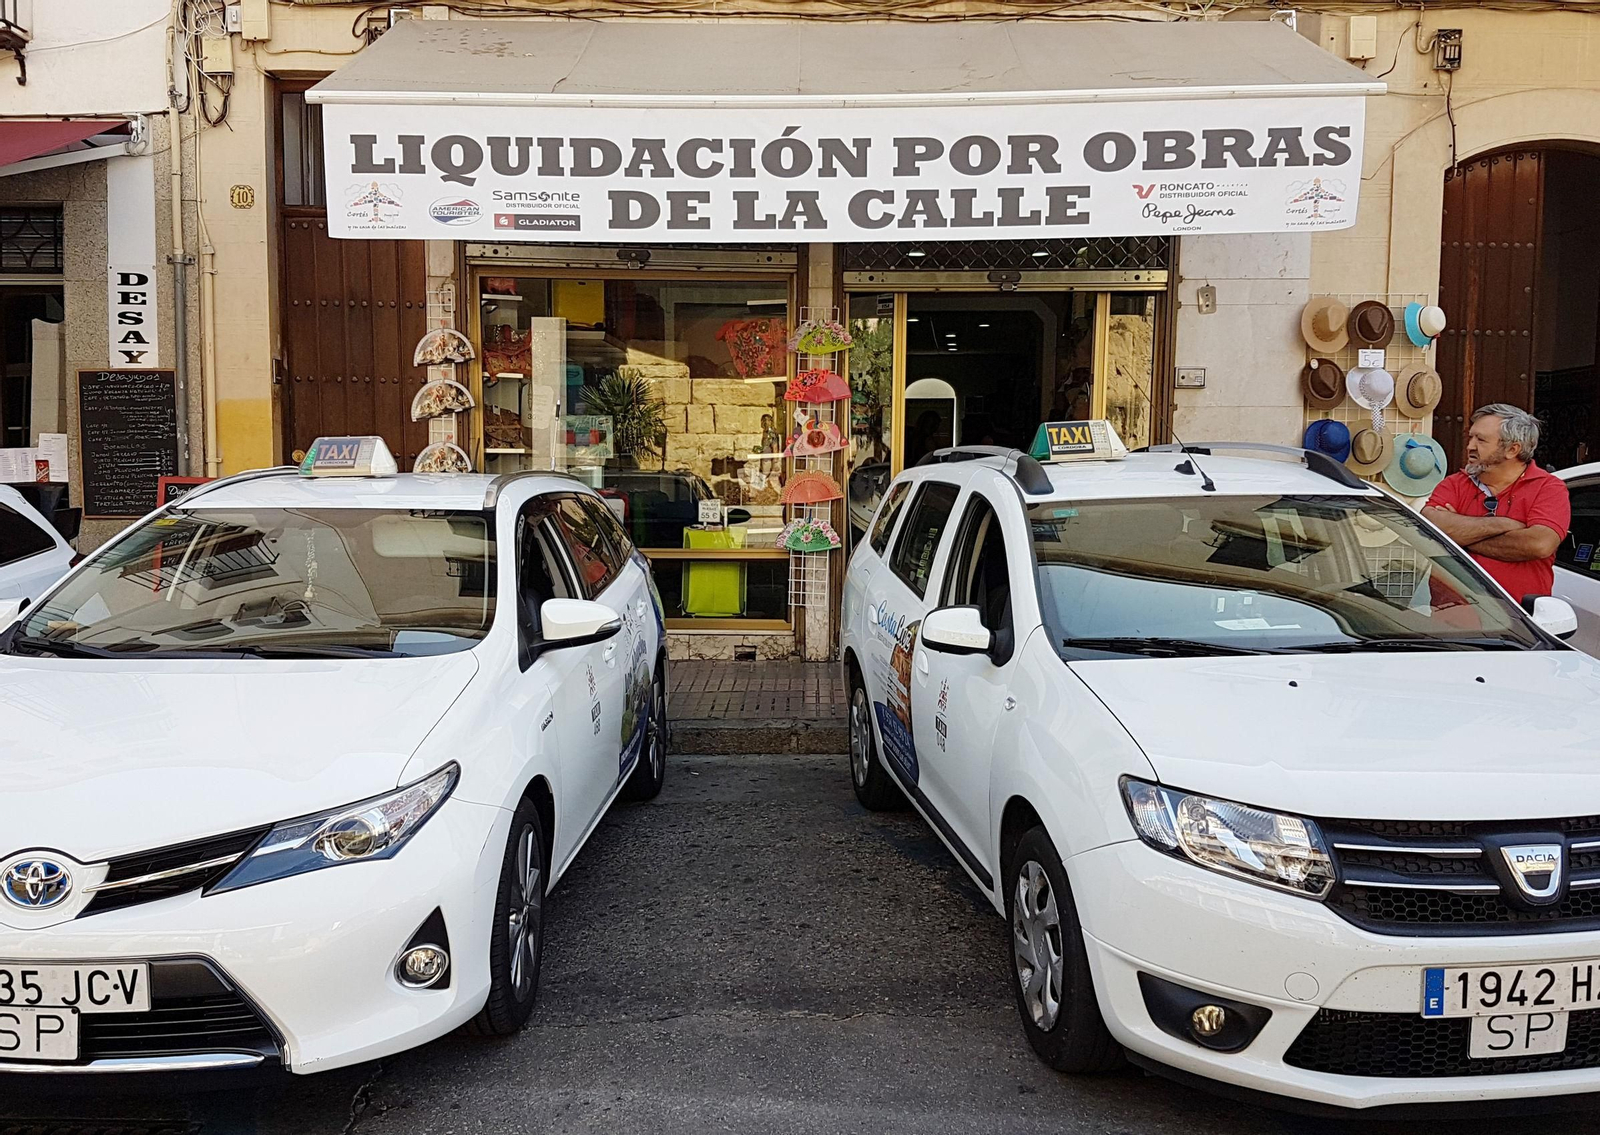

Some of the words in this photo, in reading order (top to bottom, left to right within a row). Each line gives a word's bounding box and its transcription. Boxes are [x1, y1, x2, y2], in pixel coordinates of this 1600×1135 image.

[350, 126, 872, 187] LIQUIDACIÓN
[893, 135, 1061, 177] POR
[1084, 126, 1352, 172] OBRAS
[492, 190, 580, 202] Samsonite
[1160, 182, 1214, 191] RONCATO
[236, 190, 249, 204] 10
[346, 210, 369, 218] Cortés
[608, 190, 711, 230] DE
[733, 190, 828, 230] LA
[848, 186, 1091, 229] CALLE
[1142, 202, 1183, 224] Pepe
[1183, 203, 1236, 224] Jeans
[117, 272, 150, 364] DESAY
[1048, 426, 1091, 445] TAXI
[319, 444, 358, 460] TAXI
[1516, 853, 1556, 863] DACIA
[61, 968, 138, 1006] JCV
[1458, 968, 1556, 1009] 1942
[1571, 964, 1600, 1003] H
[1429, 997, 1439, 1009] E
[0, 1013, 65, 1053] SP
[1487, 1012, 1555, 1051] SP
